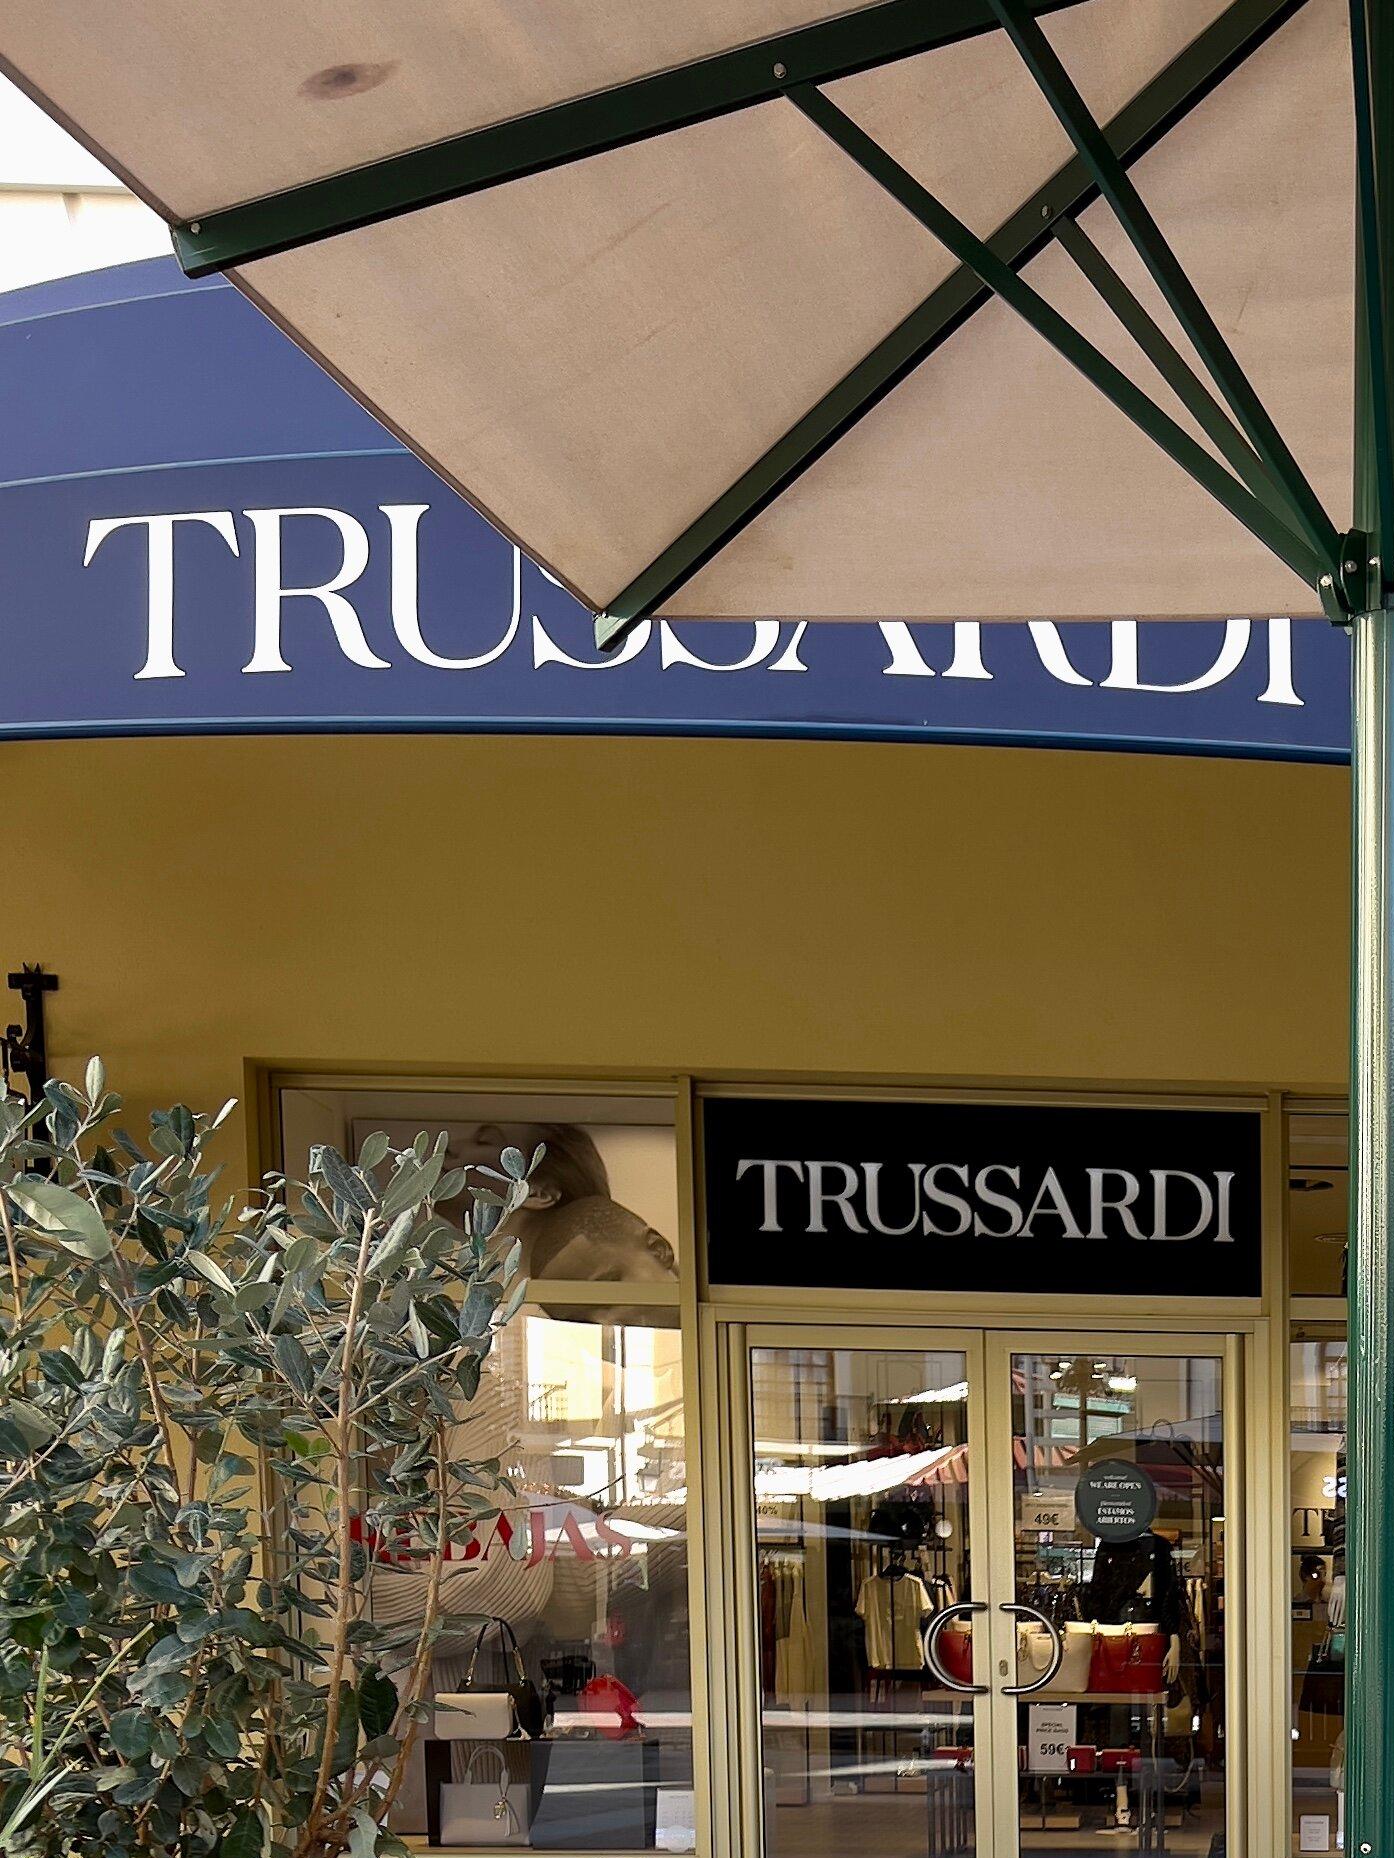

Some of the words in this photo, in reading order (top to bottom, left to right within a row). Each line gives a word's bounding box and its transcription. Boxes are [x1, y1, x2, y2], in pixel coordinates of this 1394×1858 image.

[736, 1159, 1236, 1243] TRUSSARDI
[1034, 1513, 1059, 1525] 49€
[1040, 1743, 1065, 1756] 59€
